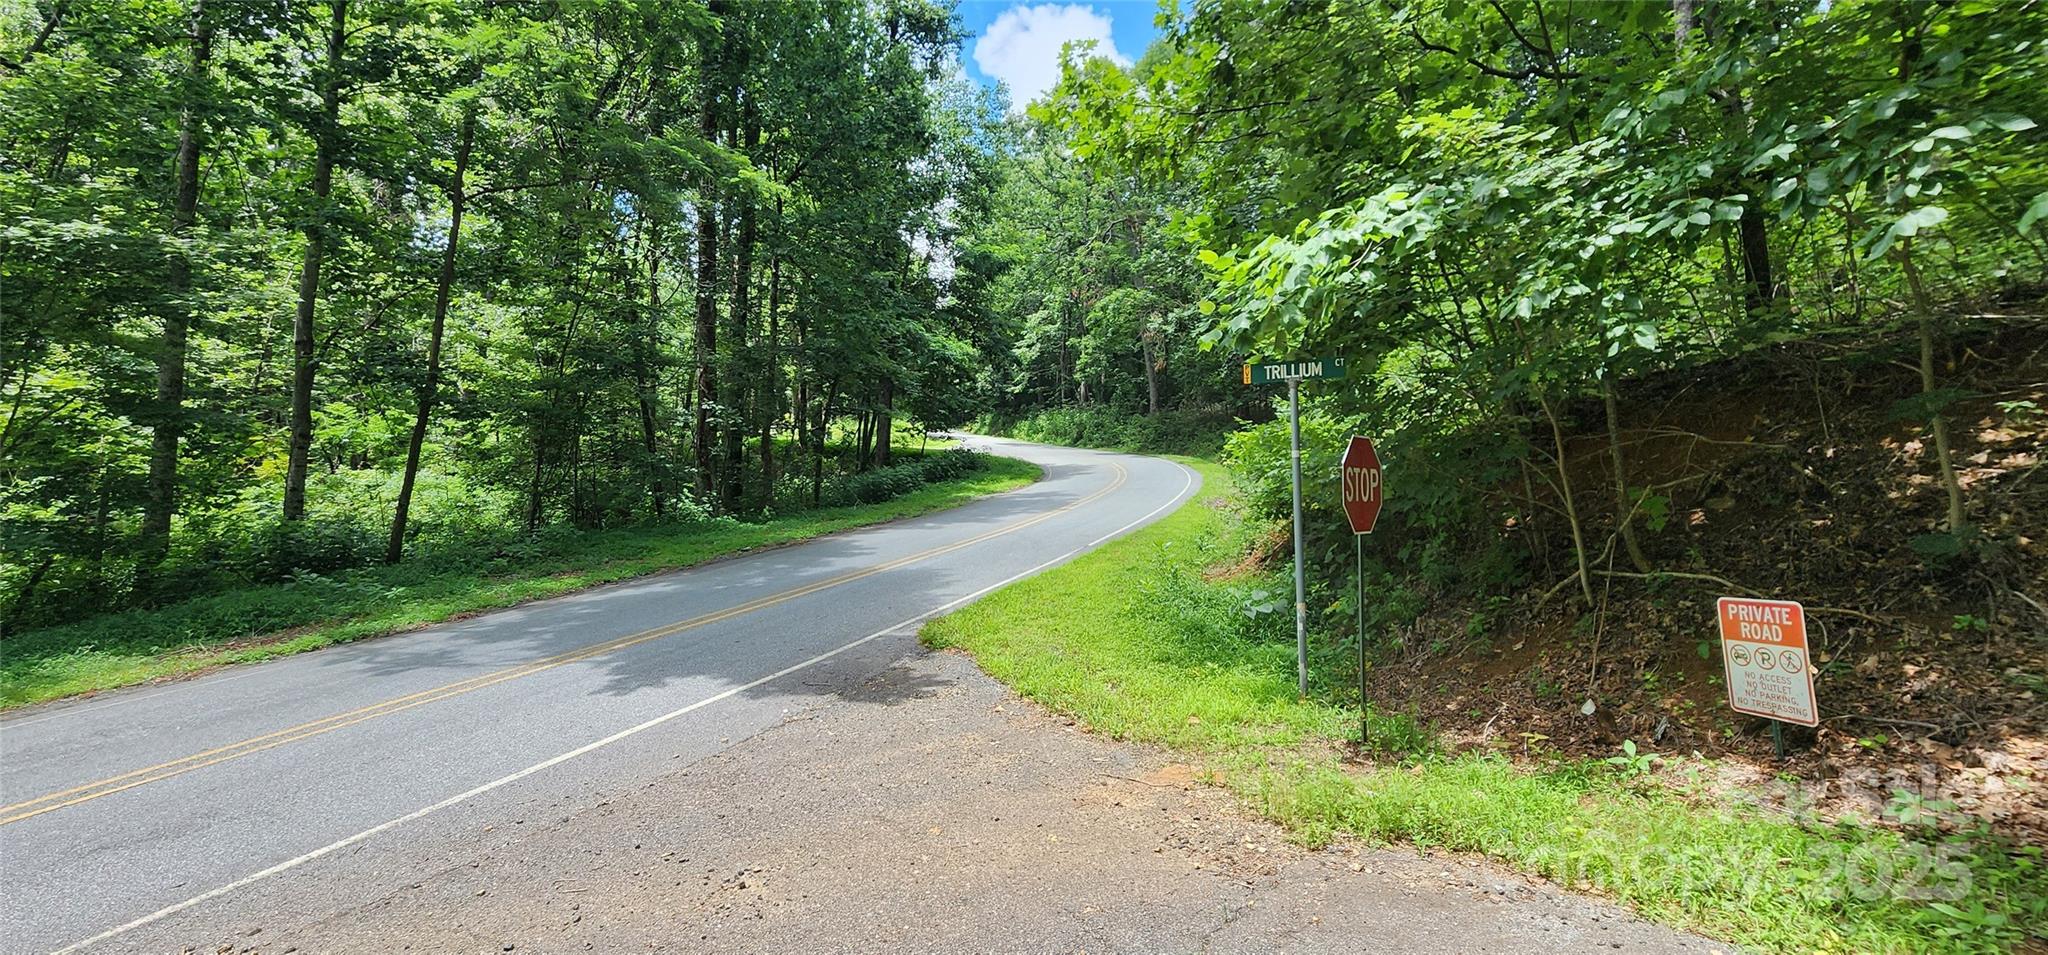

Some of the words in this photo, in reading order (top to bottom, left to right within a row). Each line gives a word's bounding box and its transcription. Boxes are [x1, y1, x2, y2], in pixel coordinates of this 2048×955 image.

[1264, 361, 1322, 380] TRILLIUM
[1334, 358, 1345, 366] CT
[1346, 466, 1379, 502] STOP
[1727, 603, 1792, 625] PRIVATE
[1741, 622, 1783, 642] ROAD
[1747, 681, 1757, 689] NO
[1761, 683, 1792, 695] OUTLET
[1760, 674, 1792, 685] ACCESS
[1738, 697, 1748, 705] NO
[1752, 699, 1808, 717] TRESPASSING
